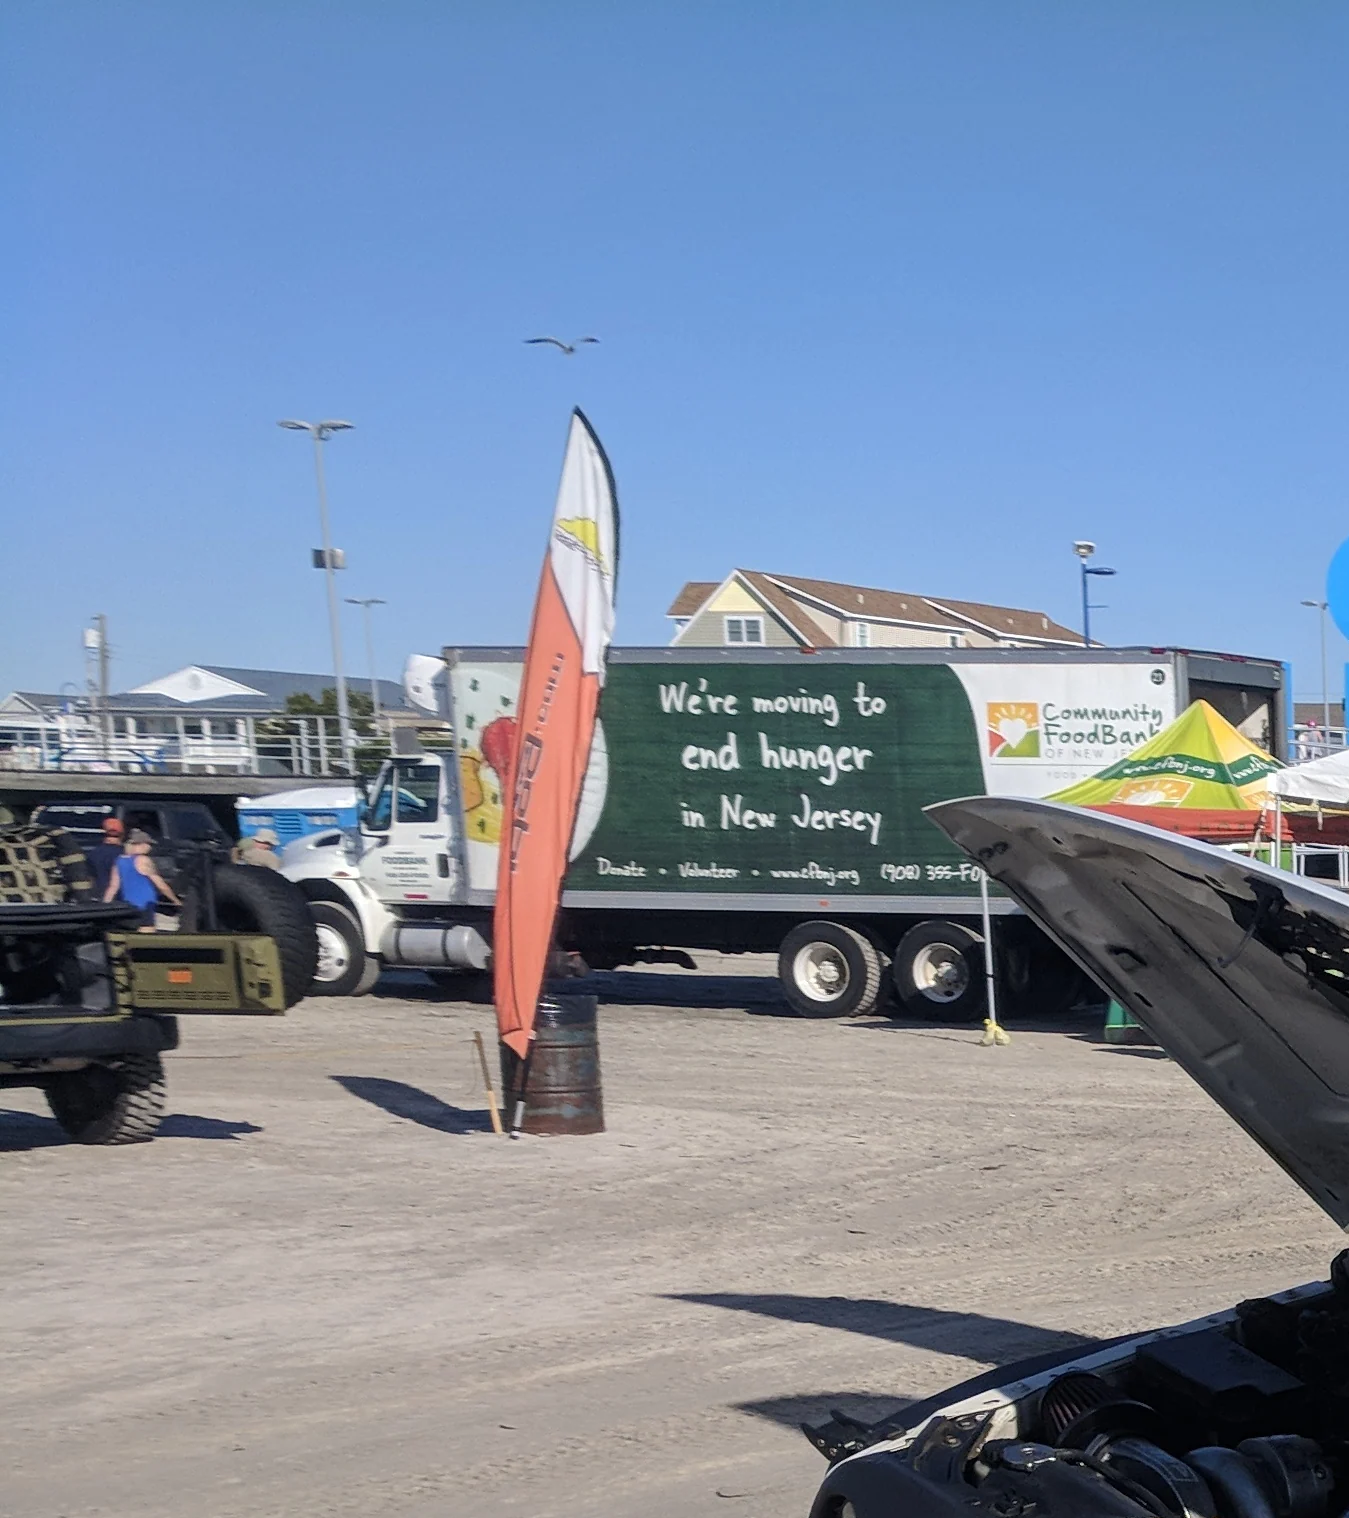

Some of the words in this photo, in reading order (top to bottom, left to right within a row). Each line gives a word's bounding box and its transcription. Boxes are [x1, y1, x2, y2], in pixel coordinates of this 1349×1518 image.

[659, 677, 740, 715] We're
[751, 687, 840, 727] moving
[852, 681, 887, 717] to
[1042, 703, 1162, 726] Community
[1044, 724, 1160, 746] FoodBank
[681, 731, 741, 771] end
[758, 731, 874, 786] hunger
[1045, 749, 1064, 759] OF
[1073, 749, 1105, 759] NEW
[679, 802, 705, 828] in
[720, 793, 777, 829] New
[791, 793, 882, 846] Jersey
[596, 856, 648, 877] Donate
